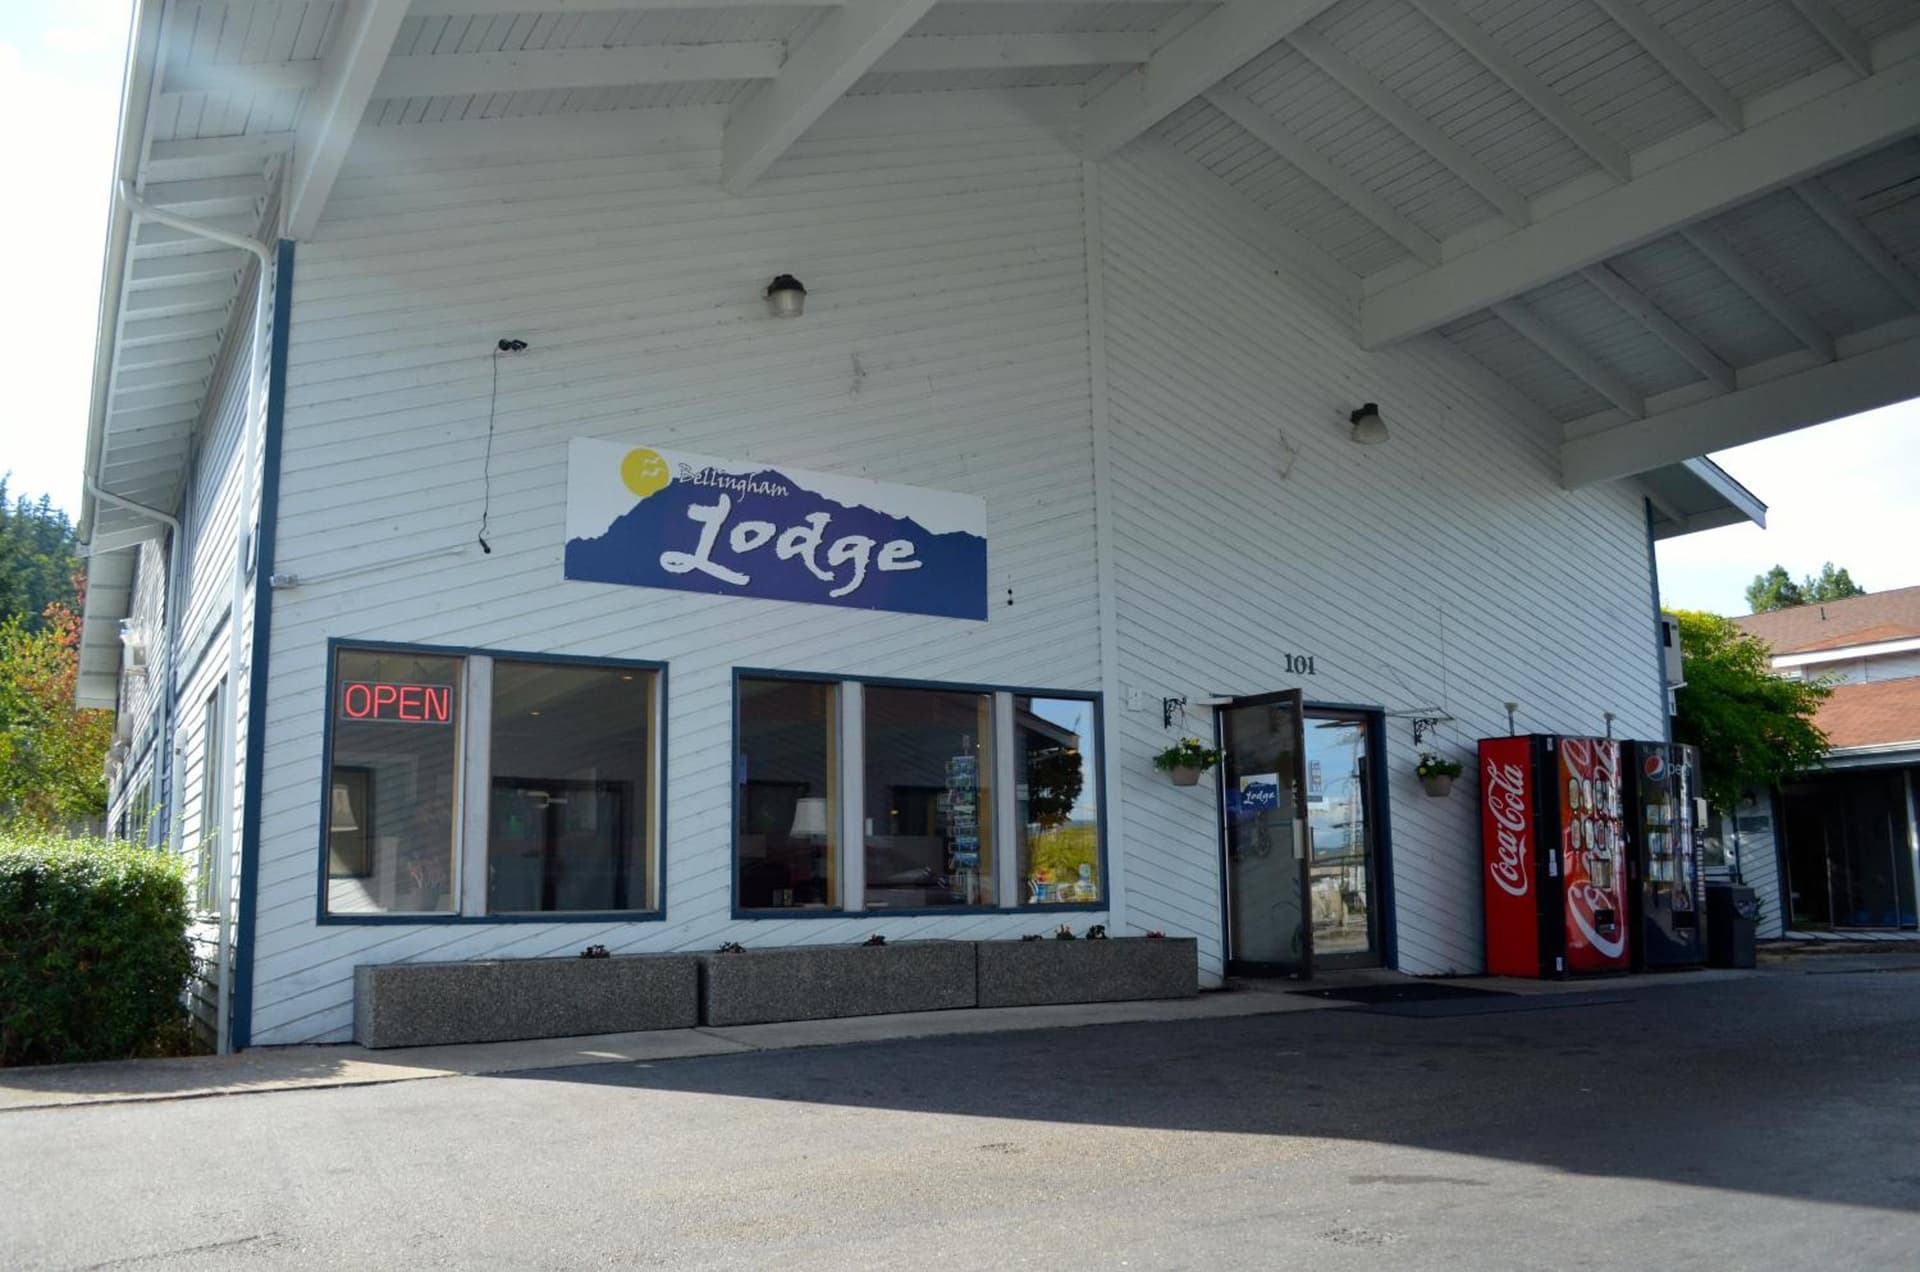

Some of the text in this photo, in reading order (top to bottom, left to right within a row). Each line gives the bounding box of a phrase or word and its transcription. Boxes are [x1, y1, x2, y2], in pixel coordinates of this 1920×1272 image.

[678, 462, 790, 503] Bellingham
[660, 493, 923, 598] Lodge
[1284, 653, 1316, 675] 101
[343, 683, 449, 721] OPEN
